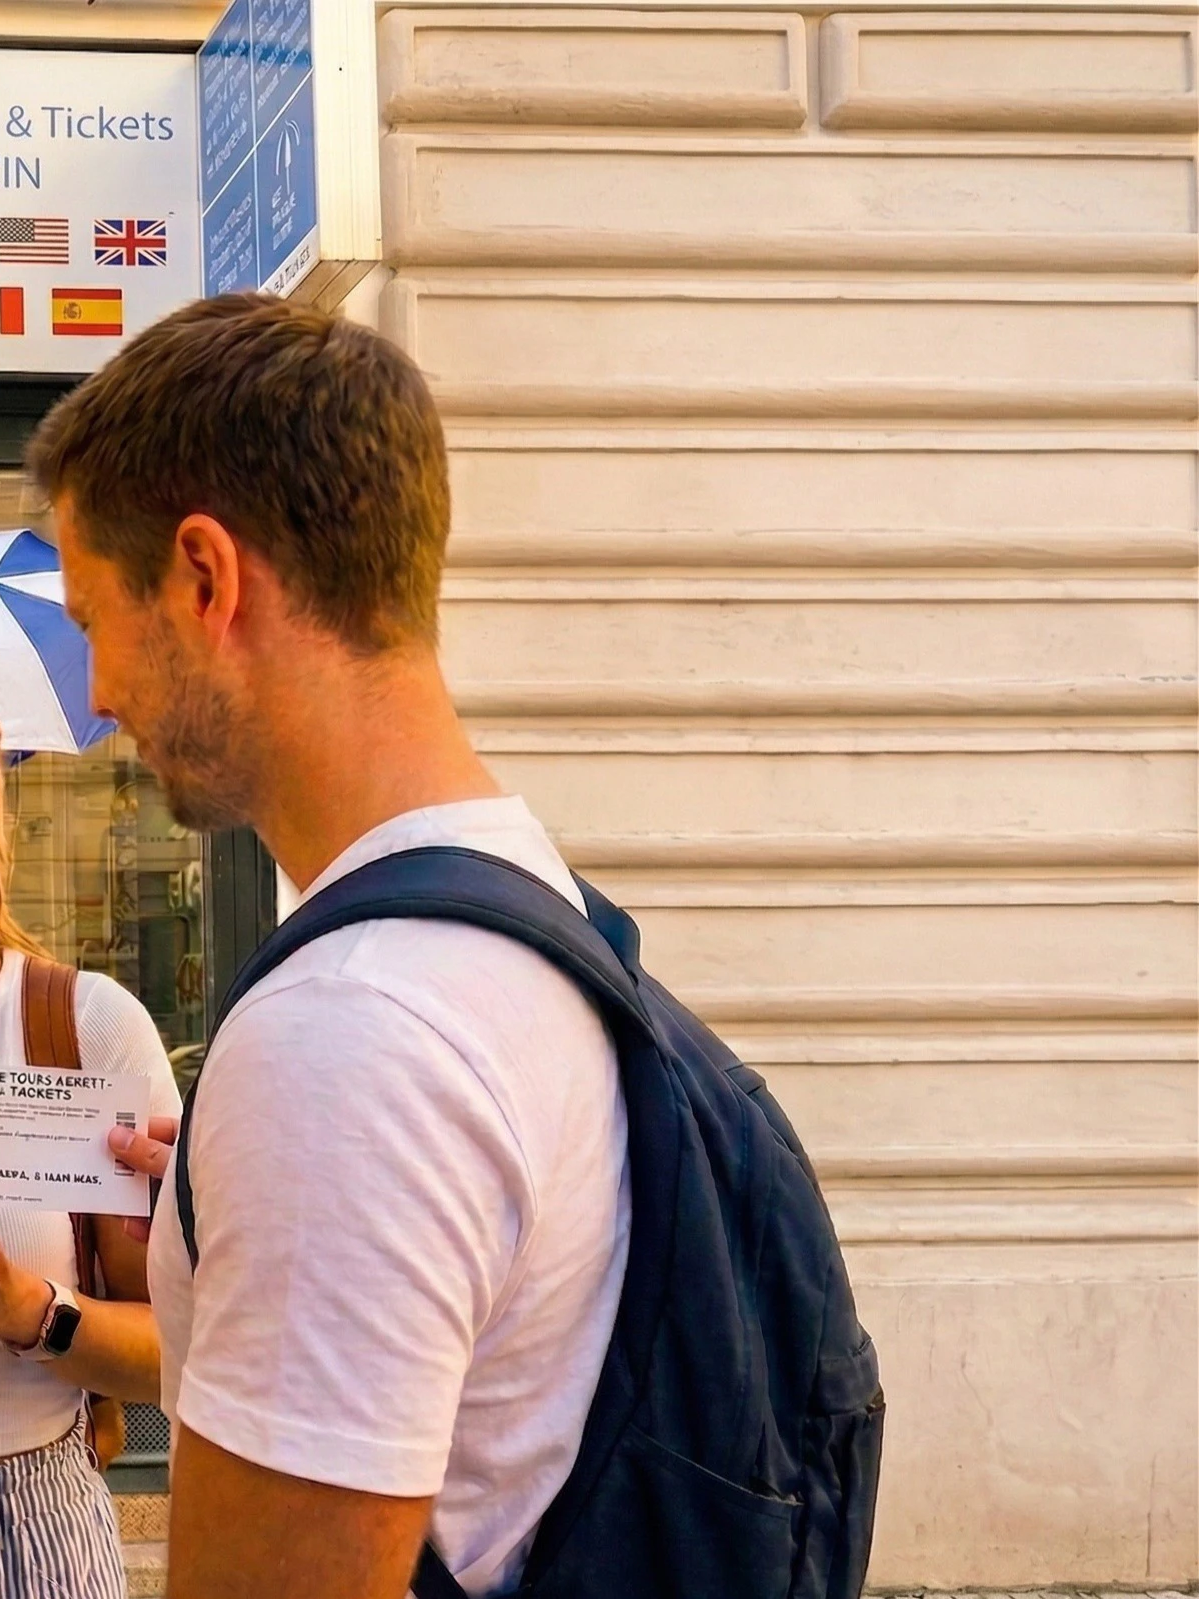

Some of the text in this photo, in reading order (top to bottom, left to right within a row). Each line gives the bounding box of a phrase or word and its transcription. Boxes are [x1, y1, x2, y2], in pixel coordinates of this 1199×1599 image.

[6, 105, 33, 138] &
[41, 106, 174, 141] Tickets
[9, 1071, 52, 1086] TOURS
